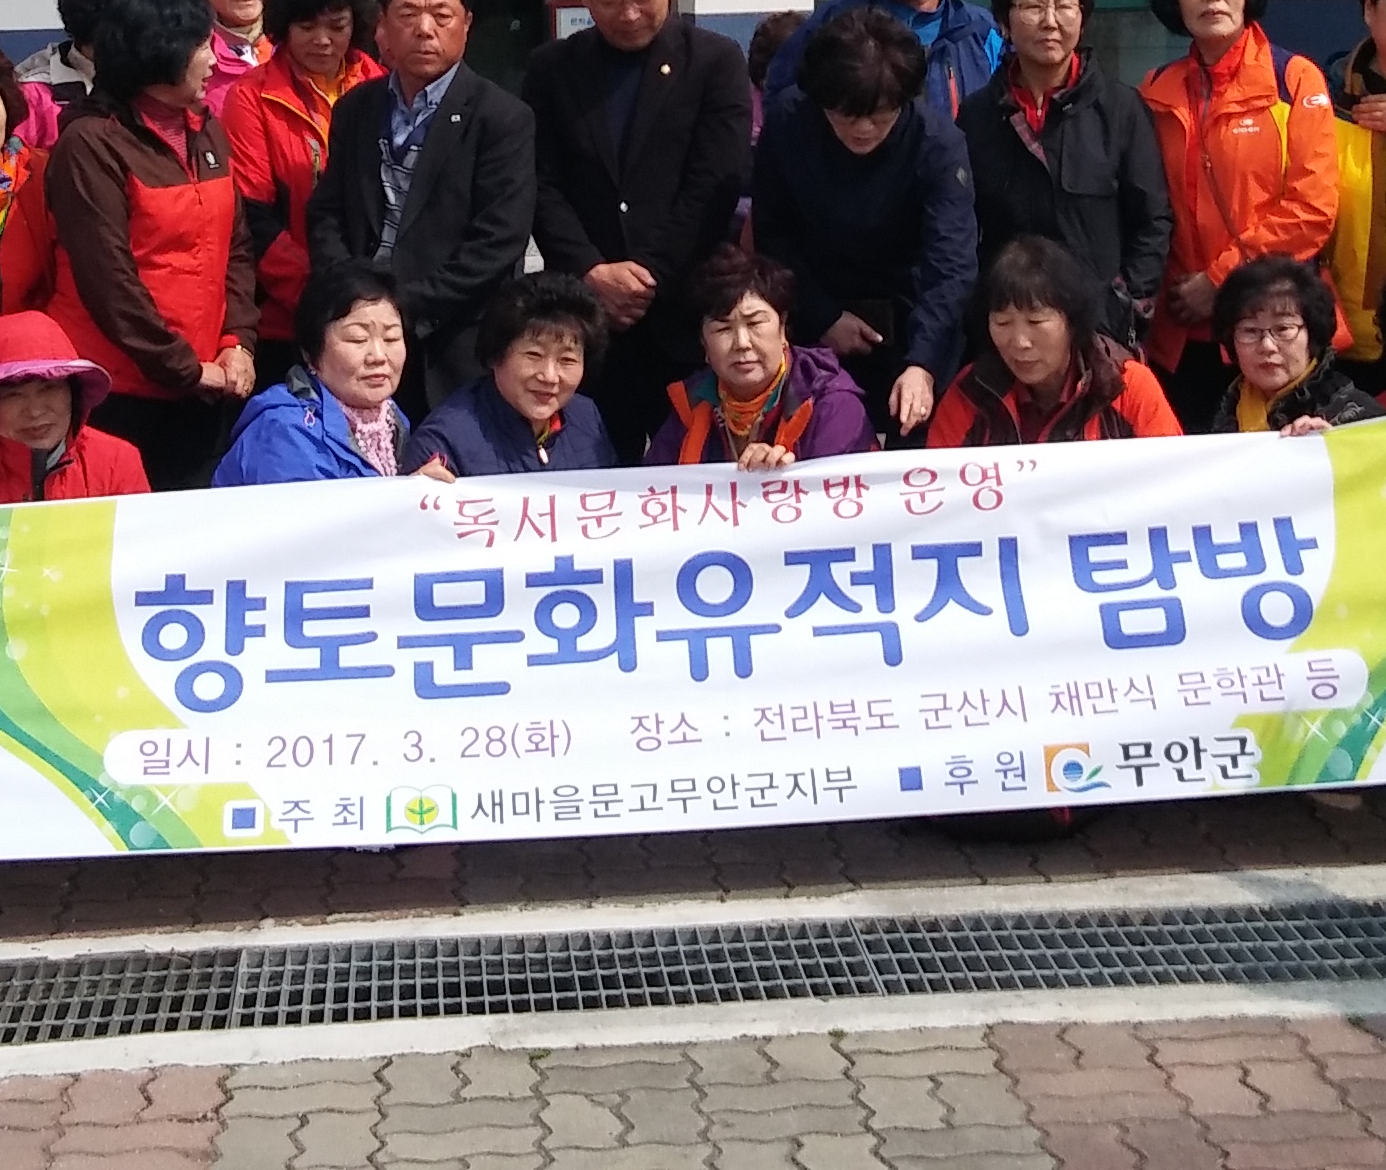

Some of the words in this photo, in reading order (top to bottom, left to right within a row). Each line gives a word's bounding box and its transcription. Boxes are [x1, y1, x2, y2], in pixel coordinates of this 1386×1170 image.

[134, 534, 1029, 714] 향토문화유적지
[1068, 514, 1319, 651] 탐방
[138, 735, 212, 776] 일시
[265, 732, 379, 769] 2017.
[460, 718, 573, 760] 28(화)
[629, 711, 703, 752] 장소
[752, 697, 900, 744] 전라북도
[918, 685, 1029, 730] 군산시
[1048, 673, 1157, 719] 채만식
[1176, 662, 1286, 706] 문학관
[1305, 656, 1341, 702] 등
[470, 766, 858, 824] 새마을문고무안군지부
[1115, 735, 1255, 789] 무안군
